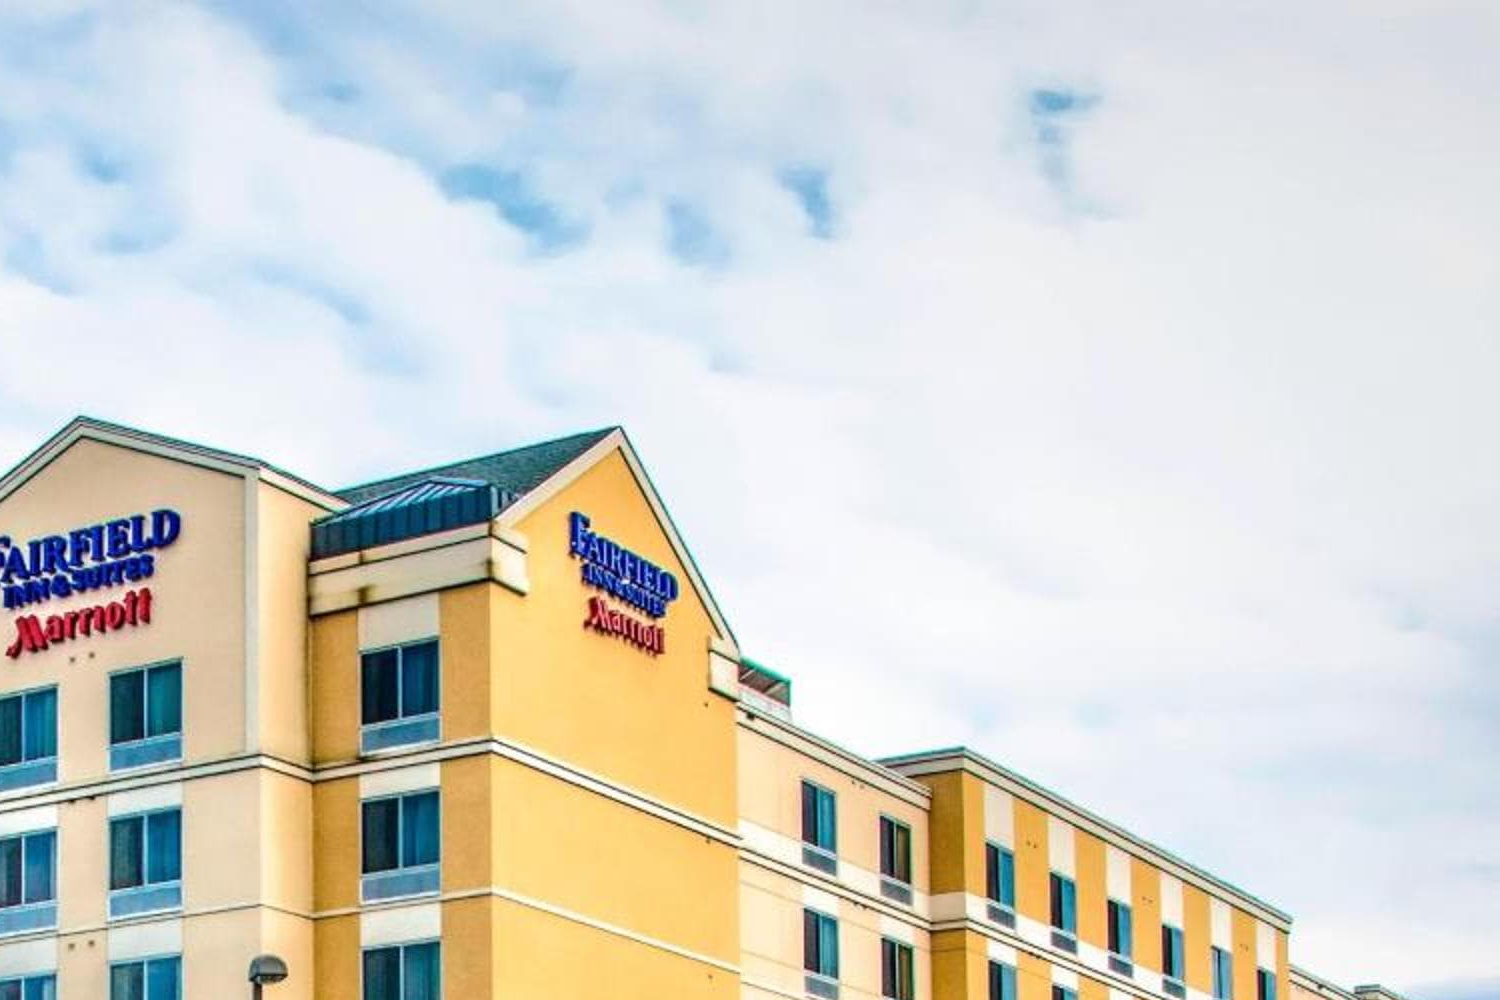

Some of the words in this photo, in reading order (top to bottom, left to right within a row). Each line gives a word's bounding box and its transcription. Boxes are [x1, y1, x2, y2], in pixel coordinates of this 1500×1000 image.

[569, 511, 679, 602] FAIRFIELD
[5, 587, 153, 660] Marriott
[583, 596, 666, 658] Marriott
